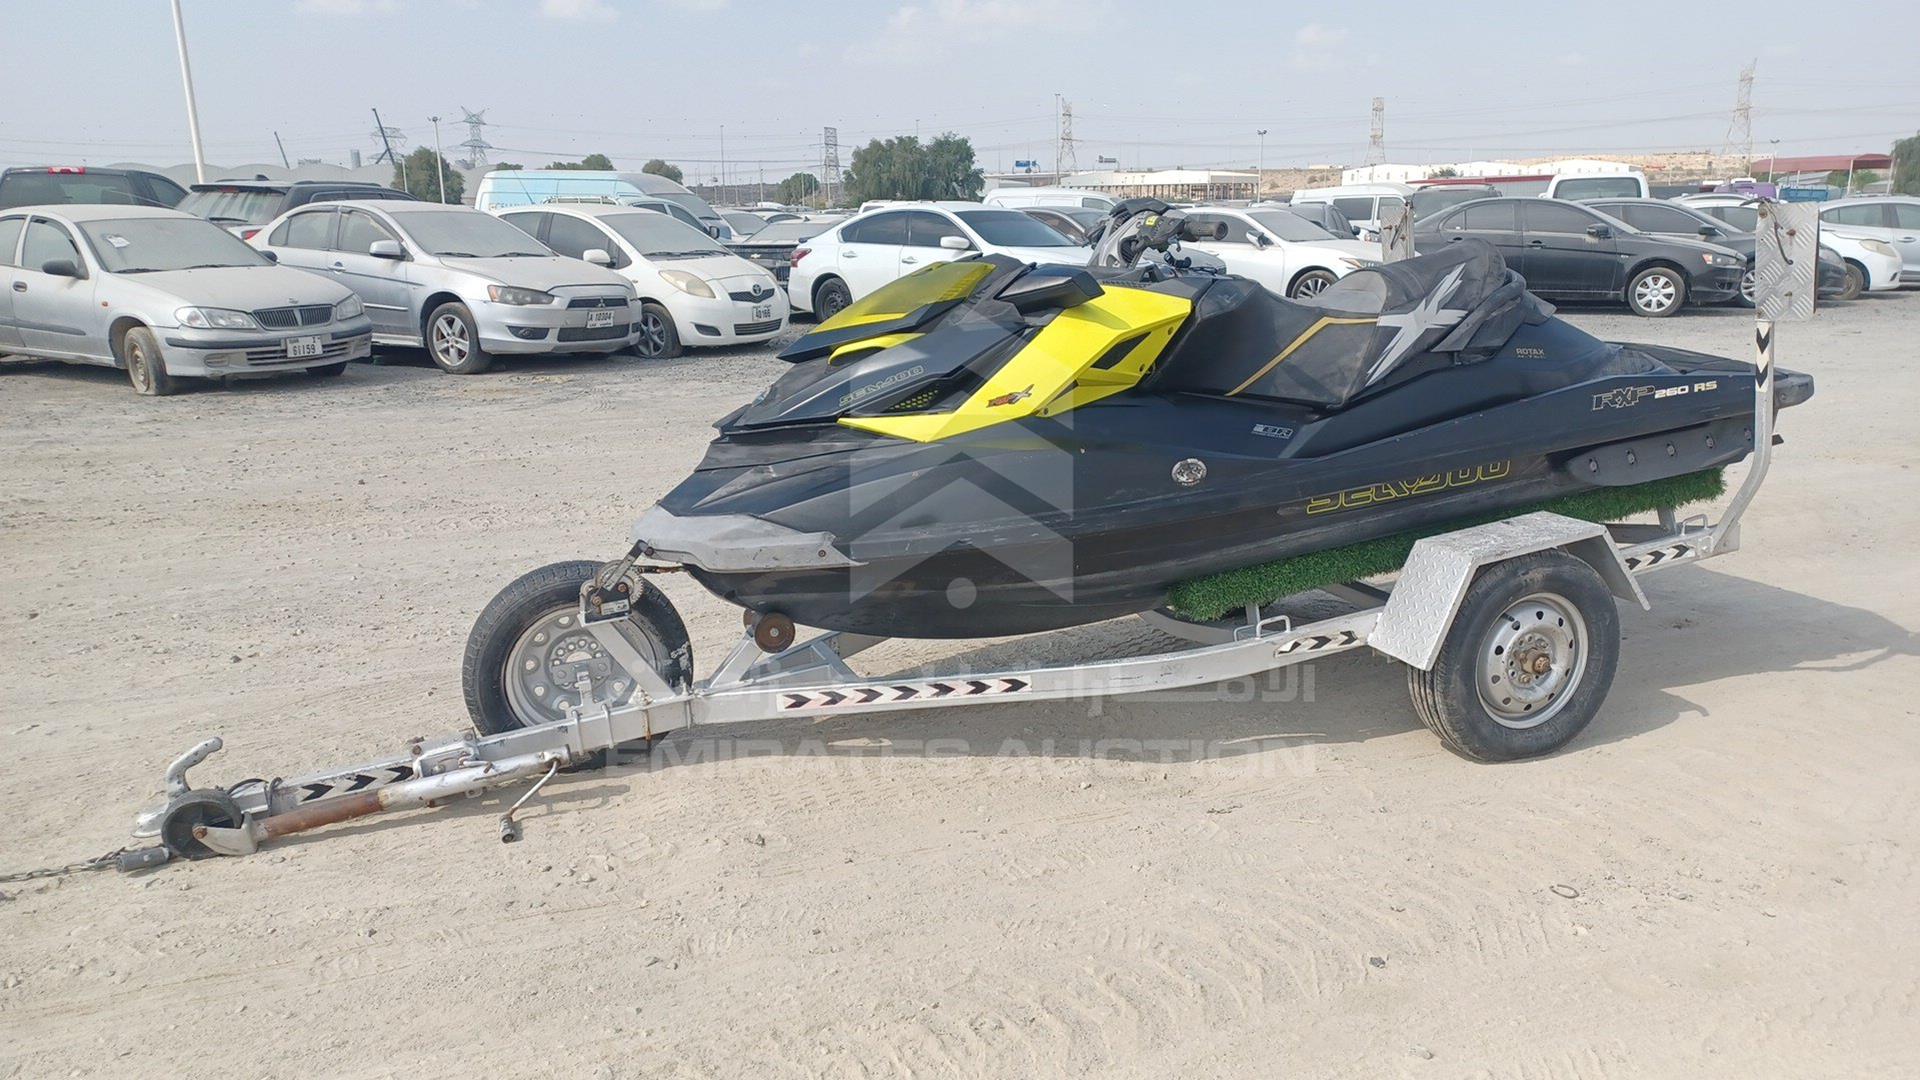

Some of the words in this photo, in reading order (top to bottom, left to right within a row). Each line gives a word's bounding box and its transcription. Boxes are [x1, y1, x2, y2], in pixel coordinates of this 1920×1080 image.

[292, 343, 316, 356] 61159
[1515, 347, 1545, 355] ROTAX
[1593, 386, 1656, 411] RXP
[1654, 385, 1689, 399] 260
[1693, 380, 1718, 393] RS
